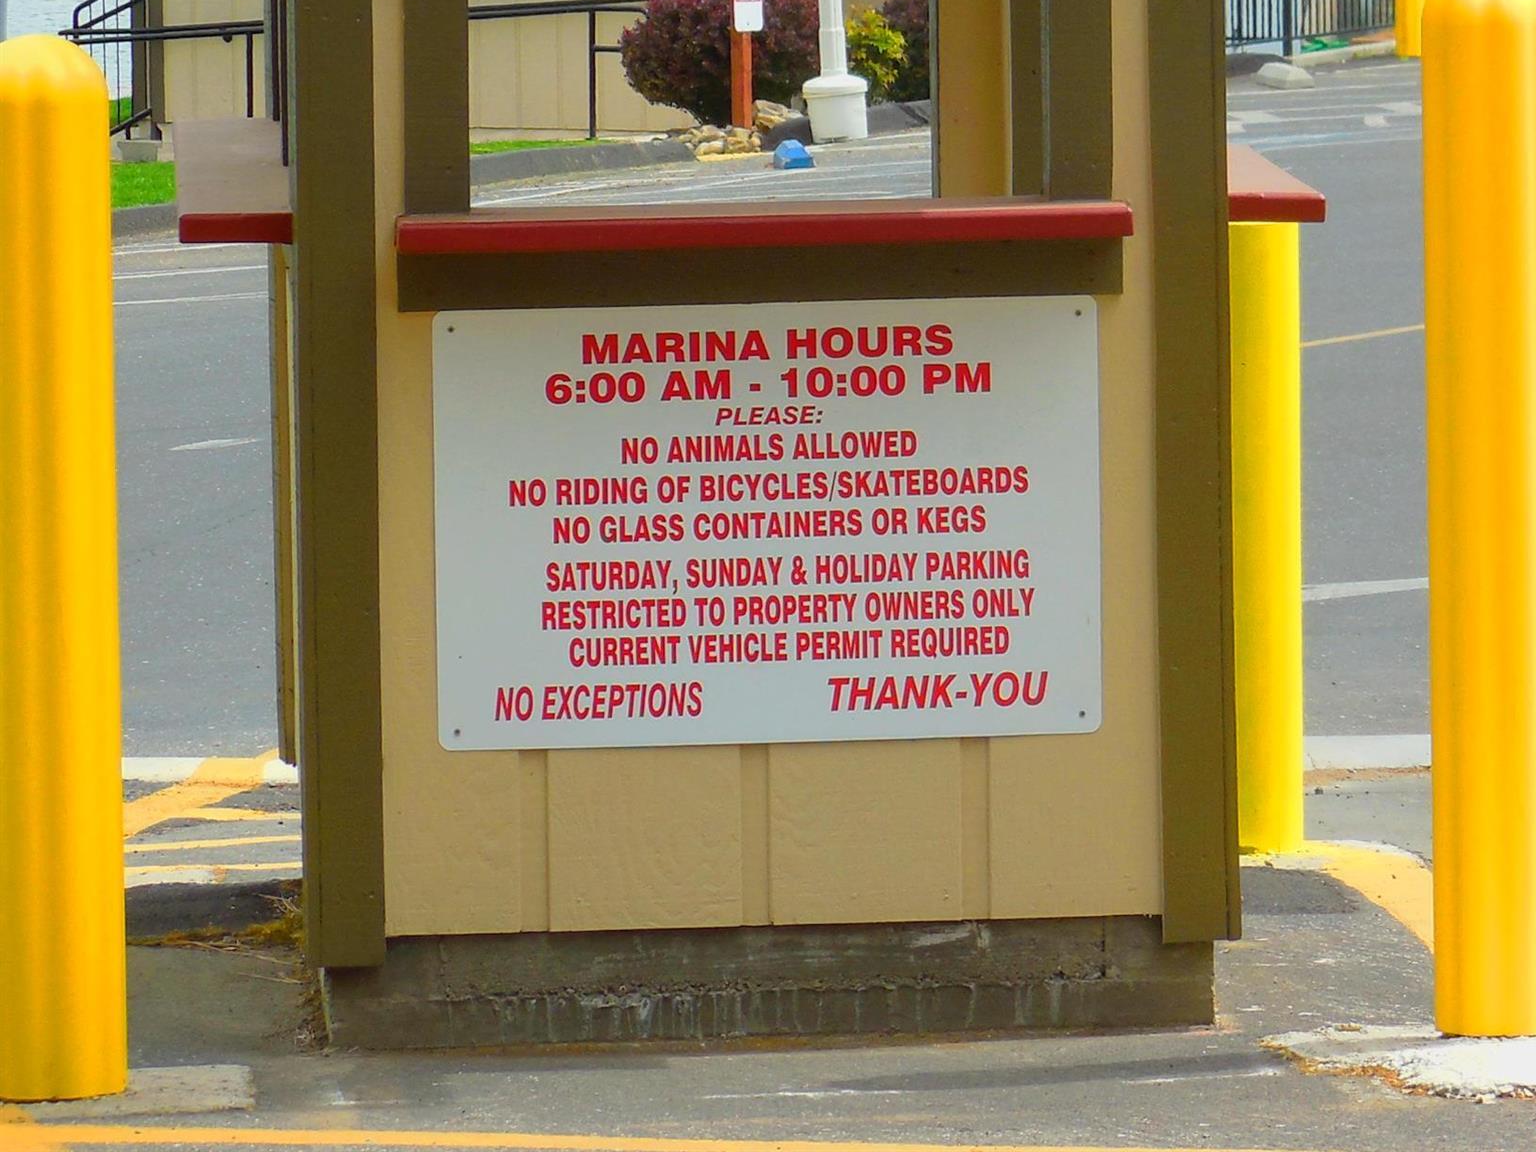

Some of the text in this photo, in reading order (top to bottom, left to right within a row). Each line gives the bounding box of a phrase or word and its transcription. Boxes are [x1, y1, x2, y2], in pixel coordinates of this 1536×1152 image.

[581, 322, 955, 365] MARINA HOURS
[545, 370, 648, 406] 6:00
[661, 368, 733, 401] AM
[780, 363, 908, 399] 10:00
[922, 360, 993, 394] PM
[714, 404, 825, 428] PLEASE:
[621, 430, 919, 465] NO ANIMALS ALLOWED
[509, 465, 1030, 508] NO RIDING OF BICYCLES/SKATEBOARDS
[553, 503, 988, 545] NO GLASS CONTAINERS OR KEGS
[546, 548, 1031, 596] SATURDAY, SUNDAY & HOLIDAY PARKING
[541, 586, 1036, 631] RESTRICTED TO PROPERTY OWNERS ONLY
[568, 624, 1011, 667] CURRENT VEHICLE PERMIT REQUIRED
[495, 681, 704, 721] NO EXCEPTIONS
[827, 670, 1050, 713] THANK-YOU
